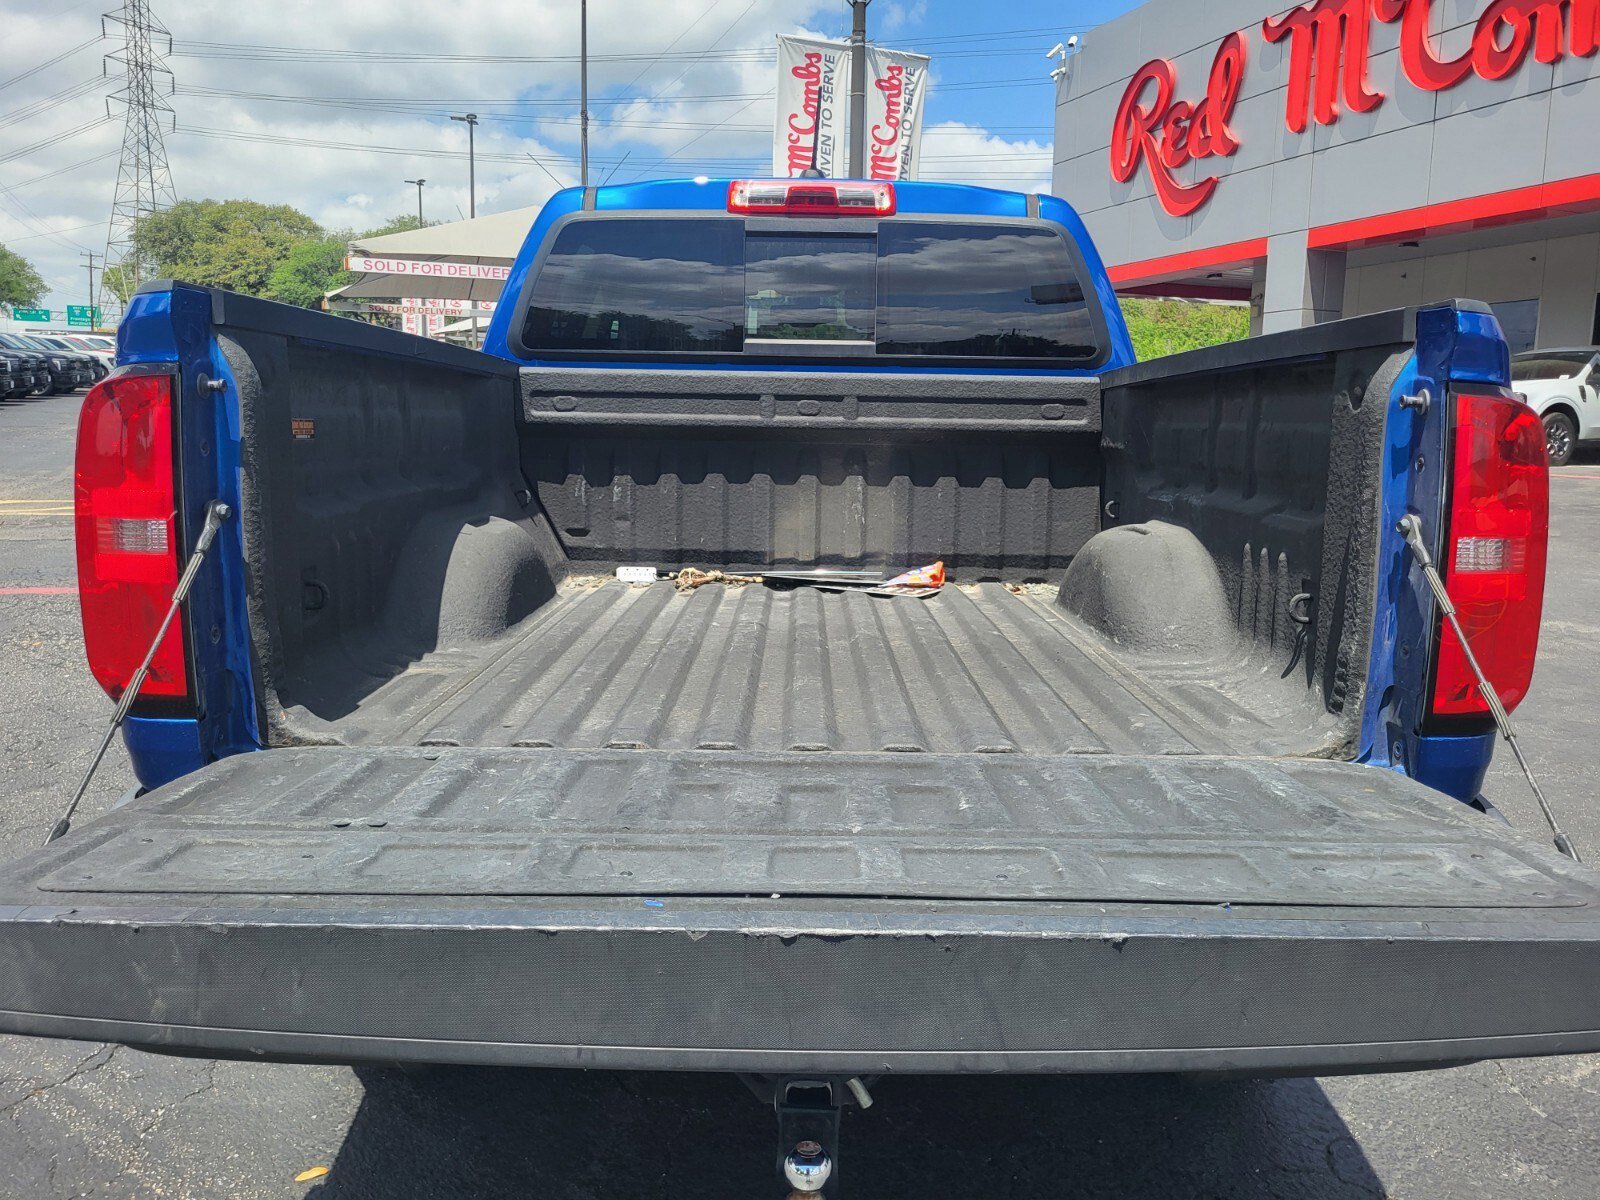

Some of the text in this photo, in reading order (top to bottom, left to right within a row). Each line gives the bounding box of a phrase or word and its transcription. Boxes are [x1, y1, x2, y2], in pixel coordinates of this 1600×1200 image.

[903, 66, 916, 114] SERVE
[820, 54, 836, 177] IVEN TO SERVE
[870, 65, 903, 180] McCombs
[901, 117, 913, 139] TO
[1110, 30, 1246, 216] Red
[363, 259, 407, 273] SOLD
[411, 262, 444, 275] FOR
[368, 304, 463, 316] SOLD FOR DELIVERY
